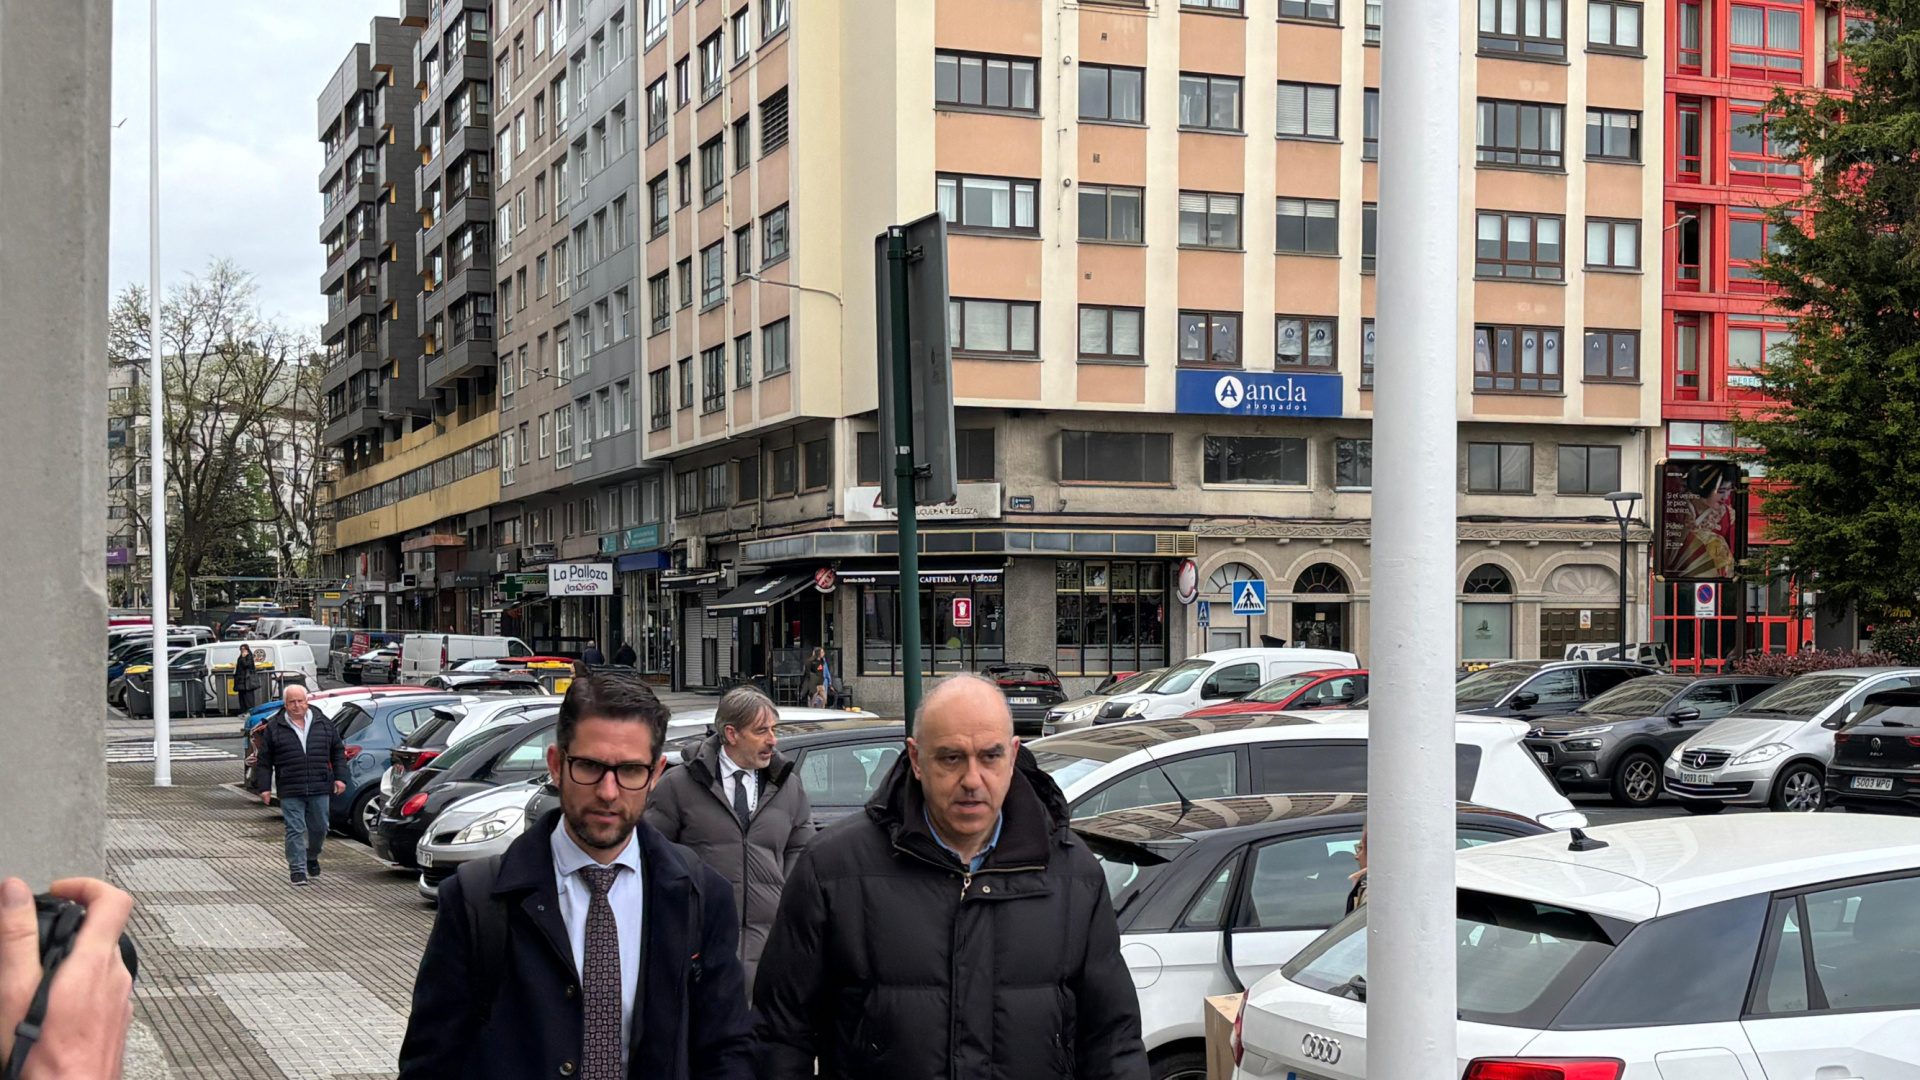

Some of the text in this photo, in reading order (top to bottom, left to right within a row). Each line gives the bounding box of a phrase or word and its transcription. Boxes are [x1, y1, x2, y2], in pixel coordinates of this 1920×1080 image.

[1246, 378, 1307, 402] ancla
[1246, 401, 1307, 412] abogados
[553, 565, 608, 581] La Palloza
[1856, 777, 1875, 788] 5003
